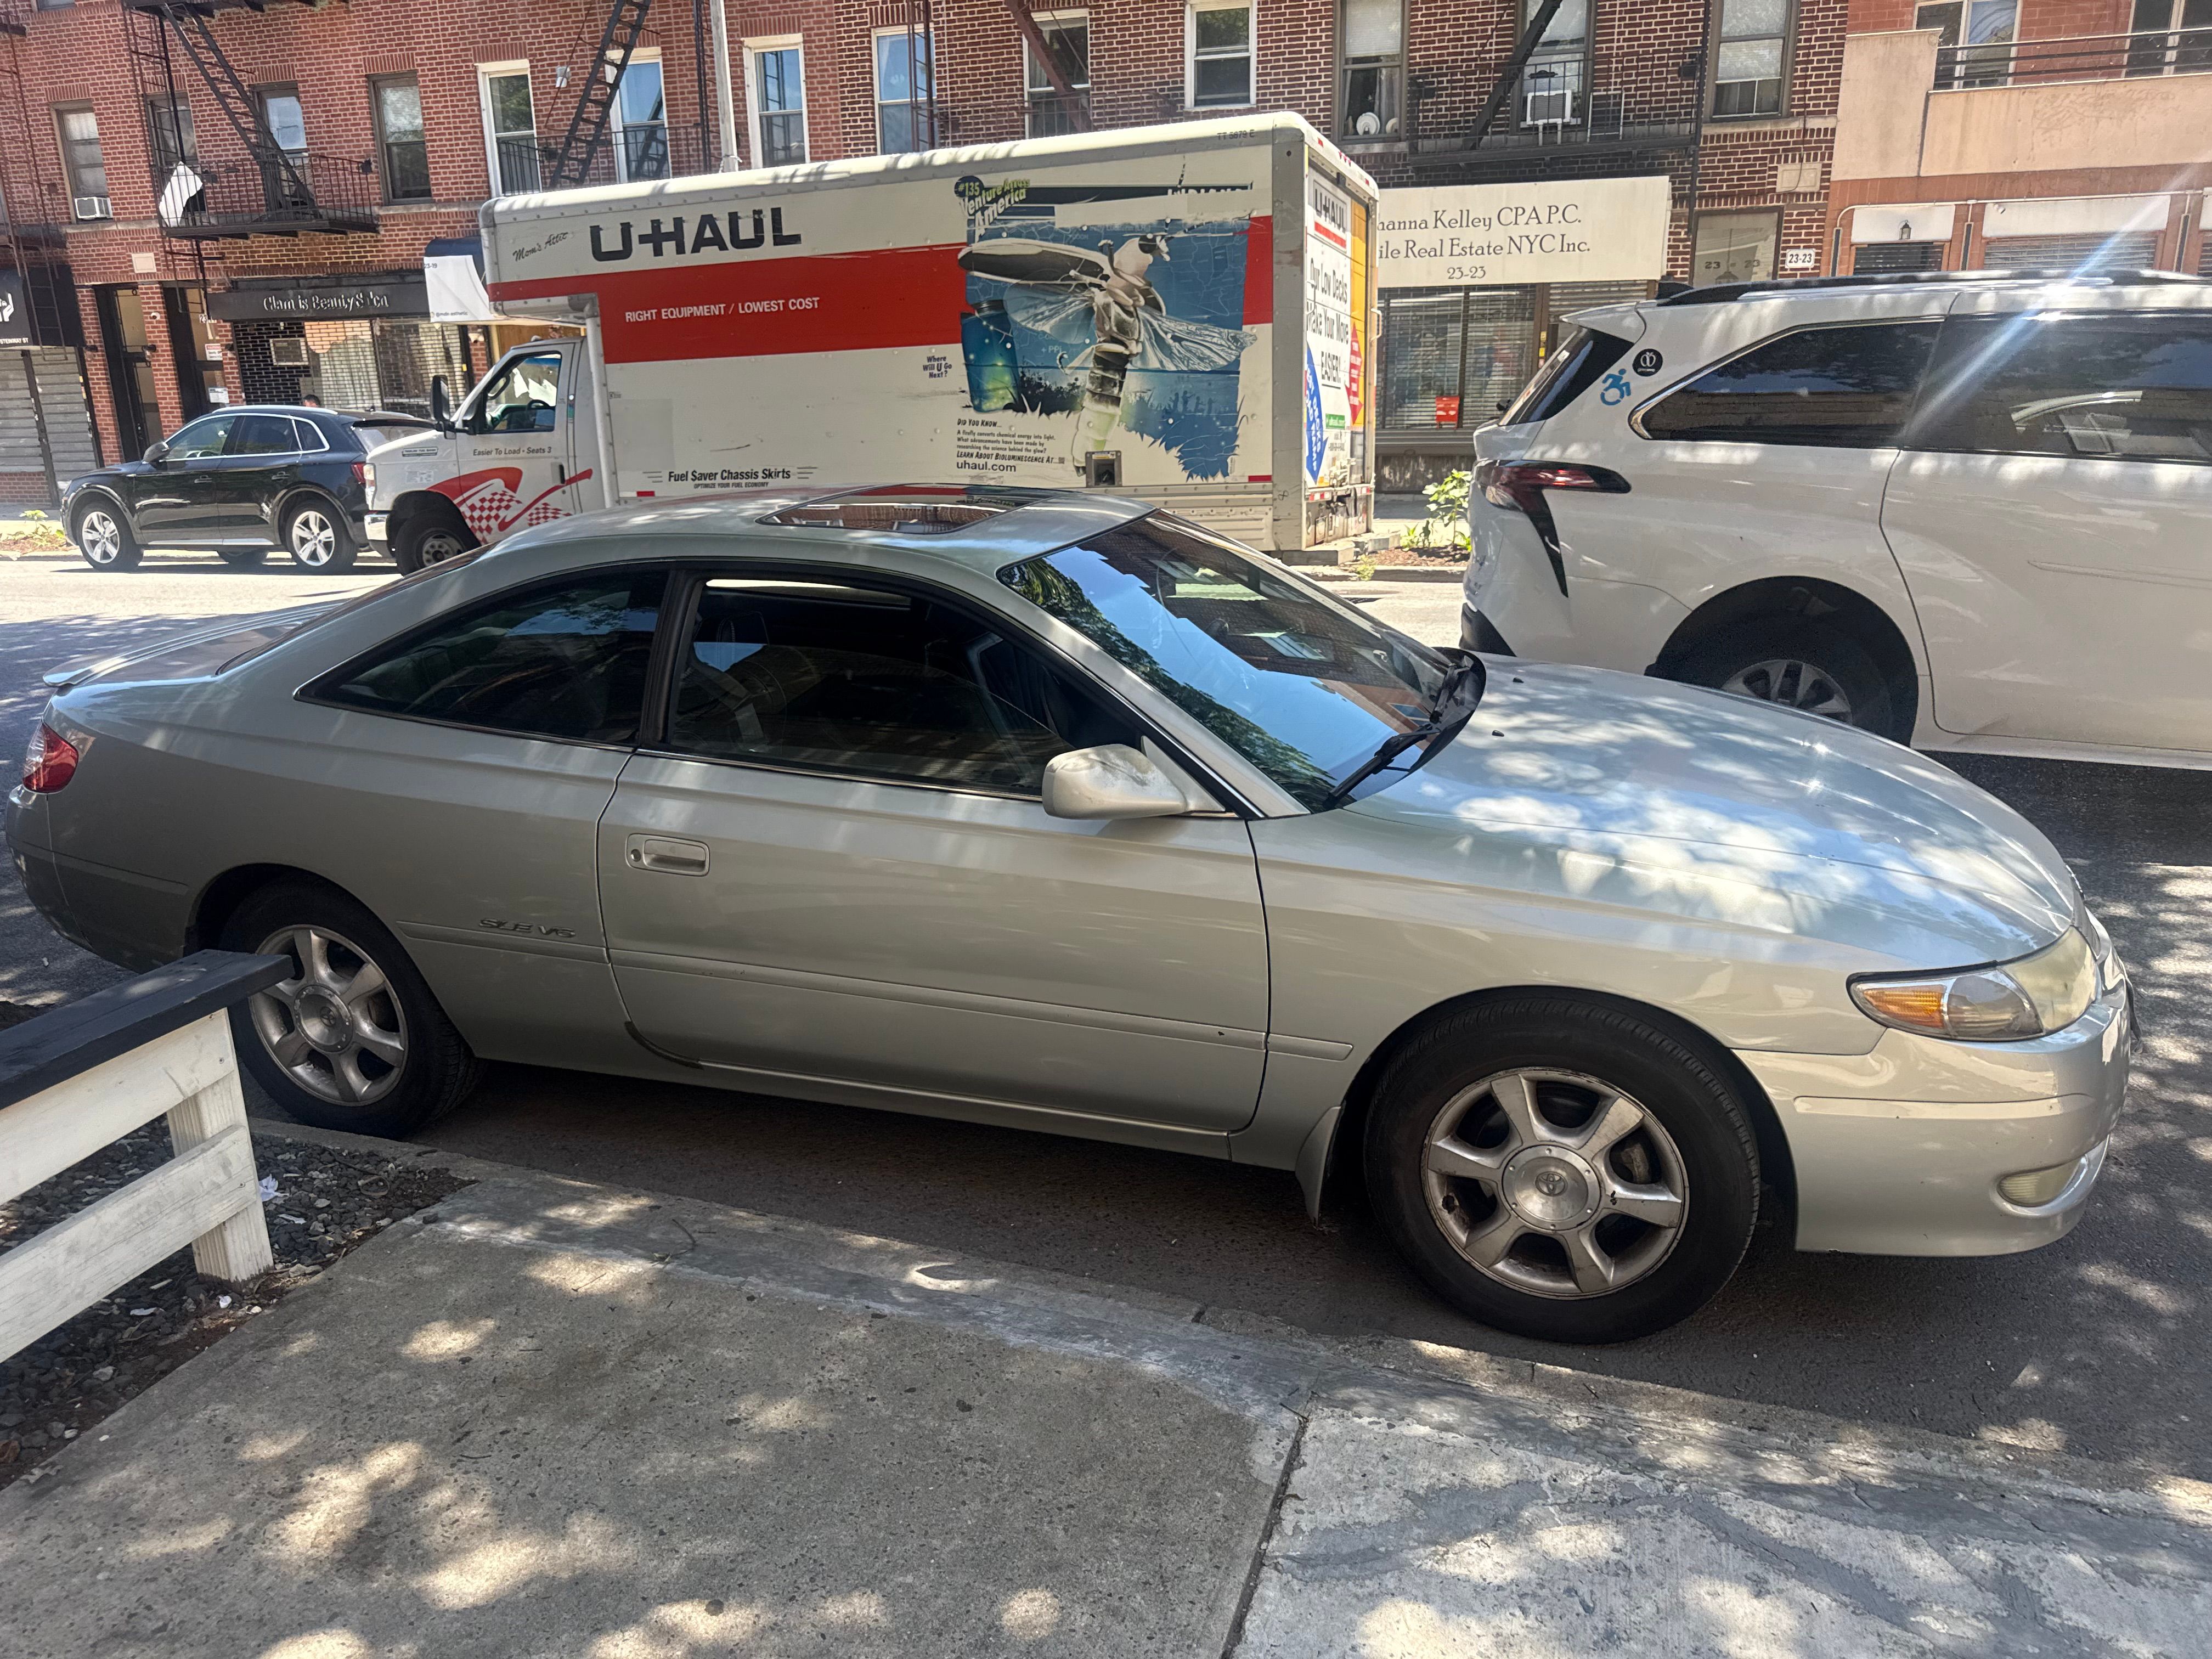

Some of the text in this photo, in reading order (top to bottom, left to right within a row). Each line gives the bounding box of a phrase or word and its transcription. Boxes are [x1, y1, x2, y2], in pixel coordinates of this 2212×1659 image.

[958, 182, 979, 196] #135
[959, 185, 1003, 218] Venture
[1315, 188, 1346, 234] U-HAUL
[974, 188, 1026, 243] America
[1433, 210, 1492, 231] Kelley
[1497, 206, 1542, 227] CPA
[1546, 204, 1582, 224] P.C.
[590, 207, 802, 262] U-HAUL
[513, 242, 543, 262] Mom's
[1404, 239, 1444, 258] Real
[1448, 238, 1503, 257] Estate
[1506, 234, 1555, 255] NYC
[1559, 234, 1590, 252] Inc.
[1788, 253, 1812, 263] 23-23
[1447, 266, 1486, 280] 23-23
[1333, 269, 1347, 304] Decks
[625, 309, 657, 322] RIGHT
[661, 303, 726, 319] EQUIPMENT
[738, 300, 785, 313] LOWEST
[789, 297, 820, 310] COST
[1323, 307, 1334, 340] Your
[1336, 313, 1348, 345] Move
[929, 370, 947, 379] Next?
[936, 363, 942, 371] U
[668, 471, 689, 482] Fuel
[721, 469, 759, 480] Chassis
[761, 468, 791, 479] Skirts
[957, 460, 1016, 472] uhaul.com
[538, 926, 575, 938] V6
